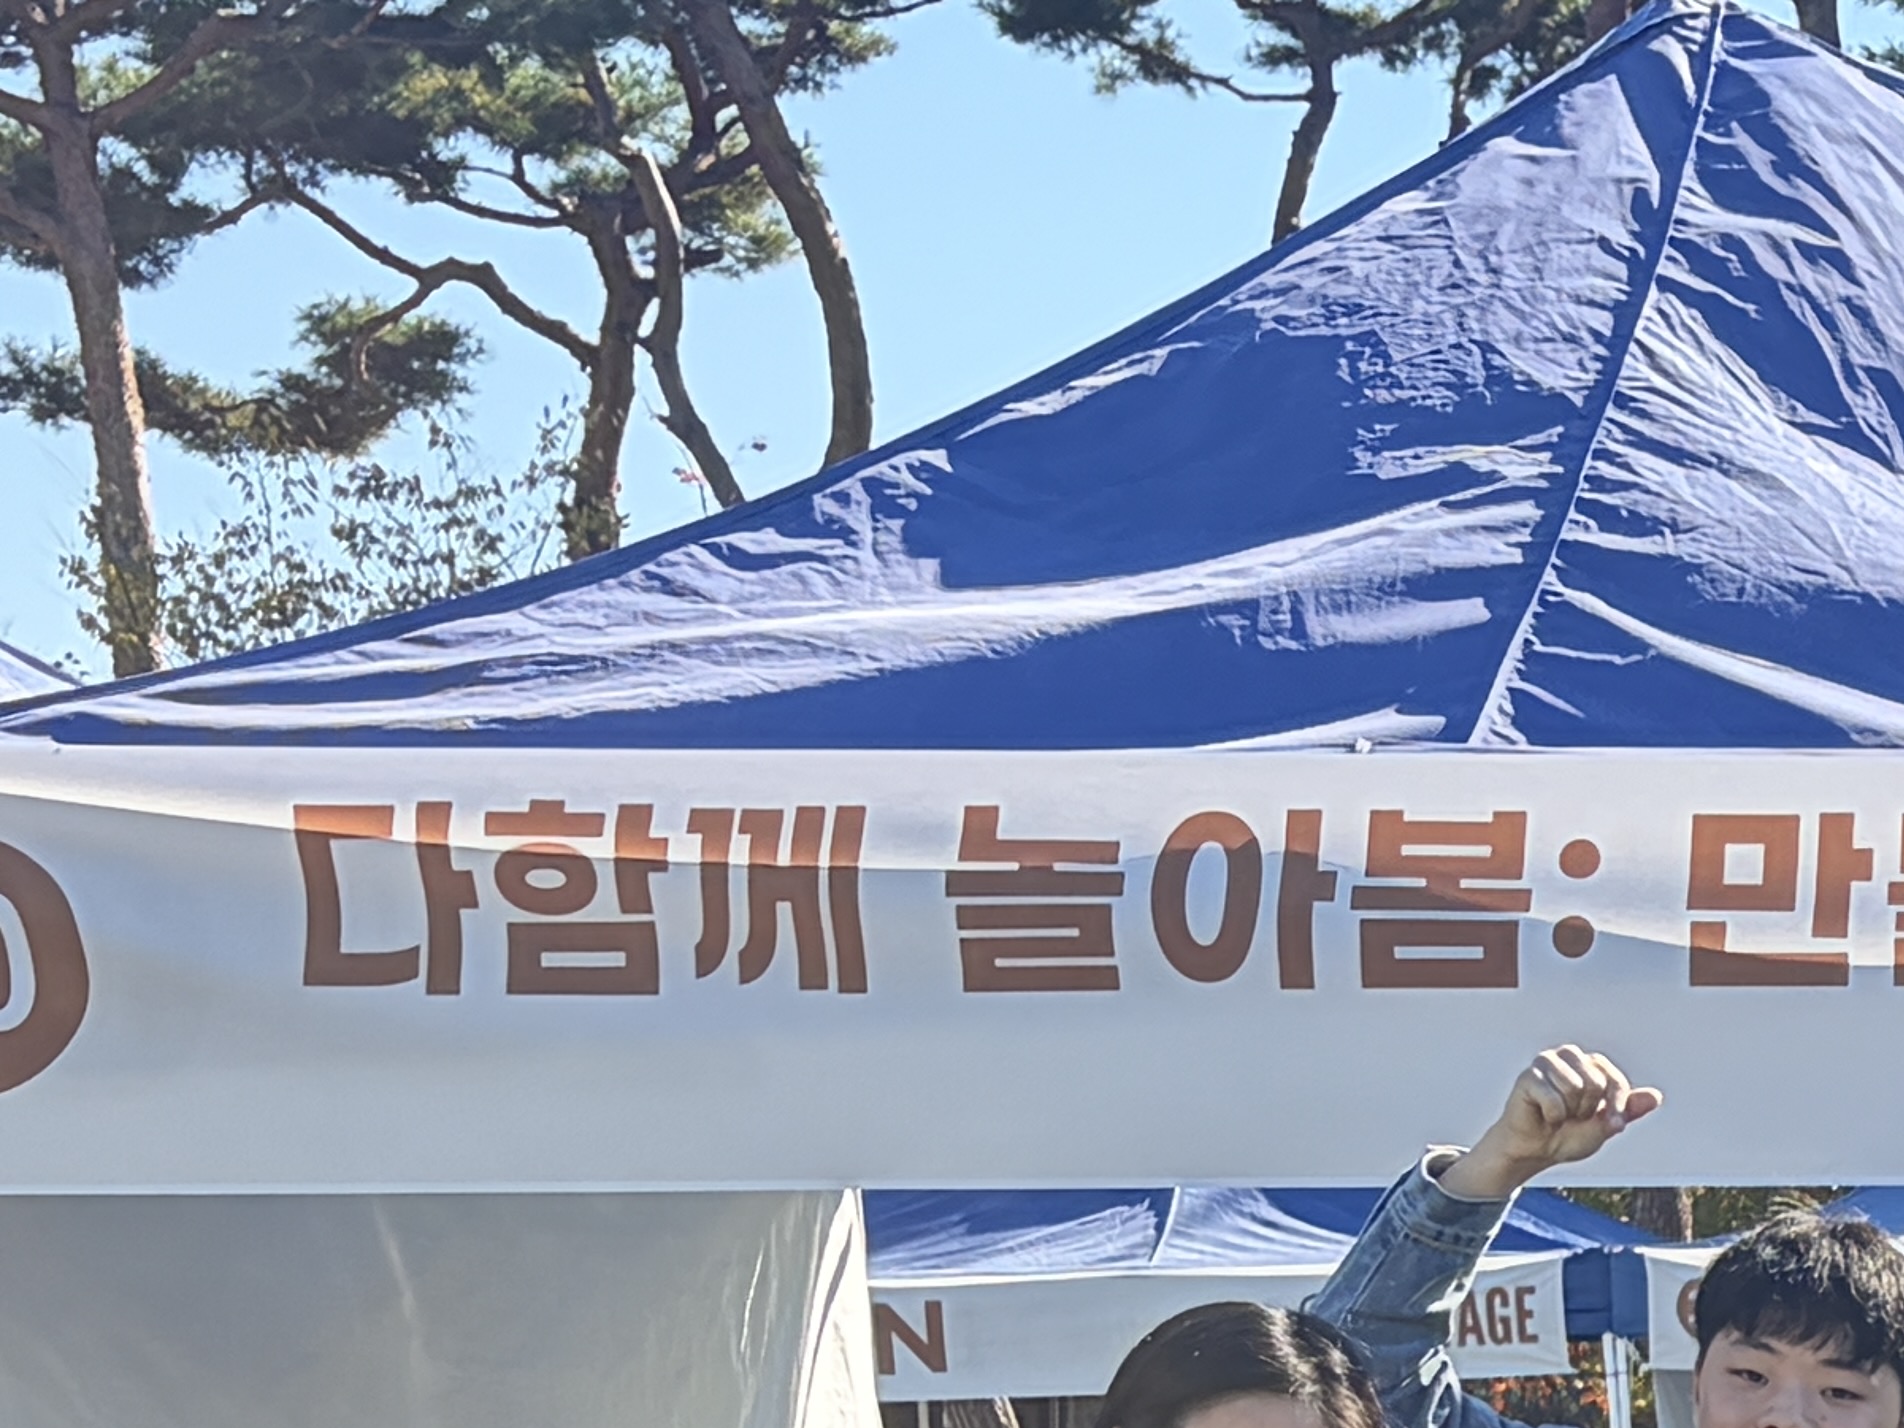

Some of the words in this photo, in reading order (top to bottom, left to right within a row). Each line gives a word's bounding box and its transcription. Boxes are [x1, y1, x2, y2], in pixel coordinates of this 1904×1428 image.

[292, 799, 868, 996] 다함께
[944, 804, 1603, 993] 놀아봄:
[1457, 1286, 1540, 1347] AGE
